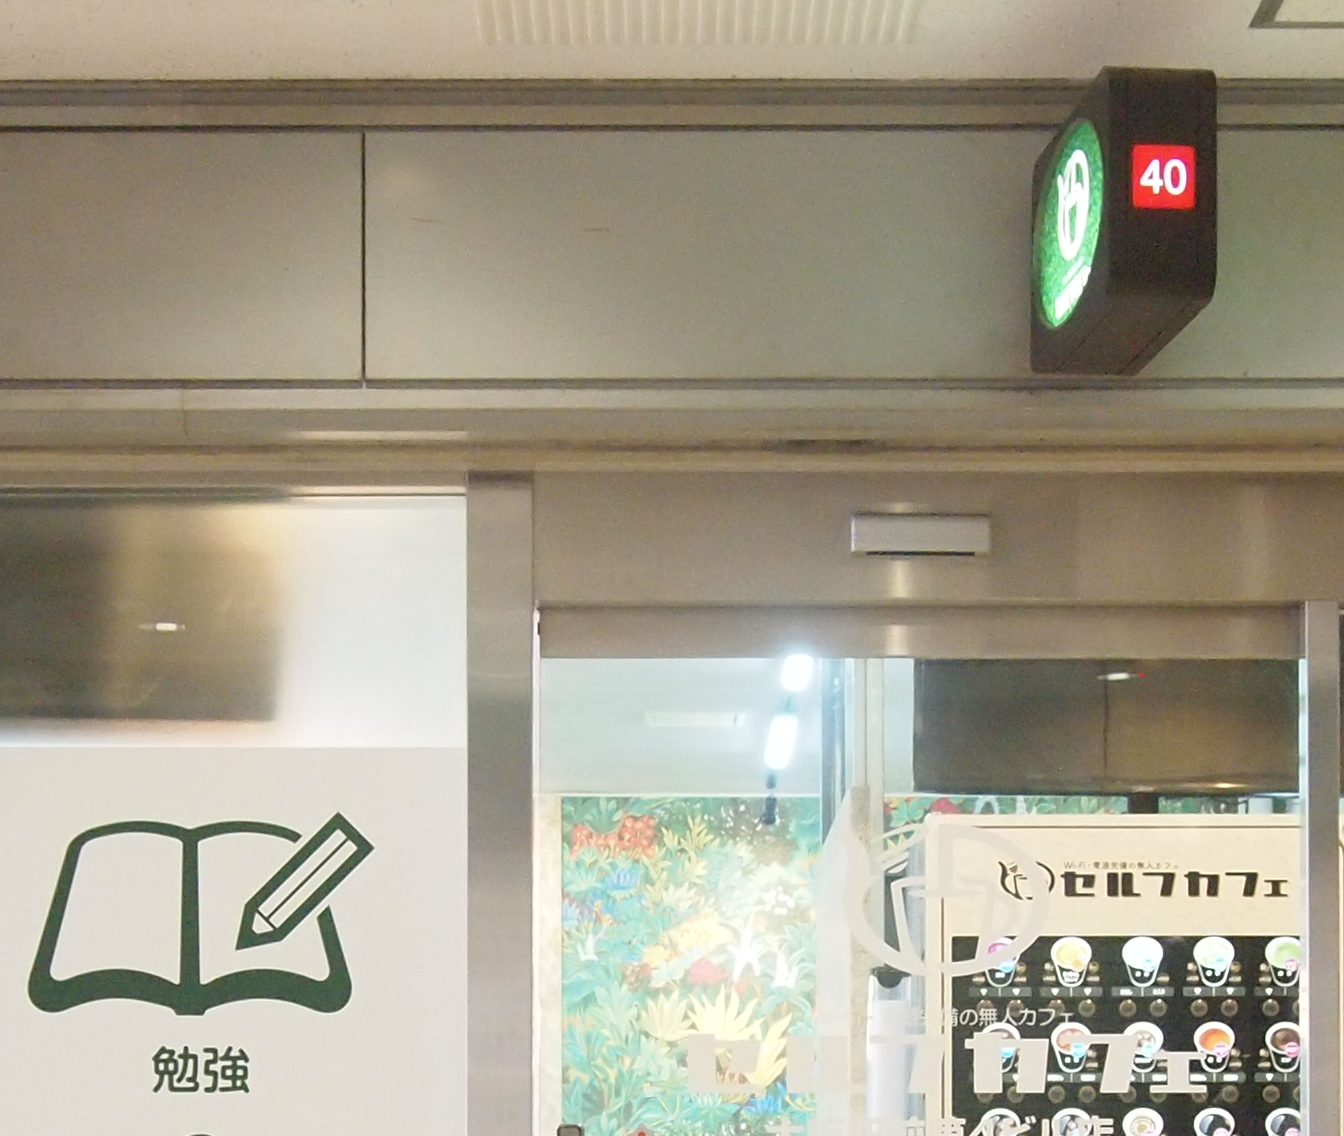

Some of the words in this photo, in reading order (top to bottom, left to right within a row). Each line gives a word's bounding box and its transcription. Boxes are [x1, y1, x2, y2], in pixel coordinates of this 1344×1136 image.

[1139, 158, 1187, 196] 40
[1060, 871, 1288, 898] セルフカフェ
[151, 1045, 250, 1094] 勉強
